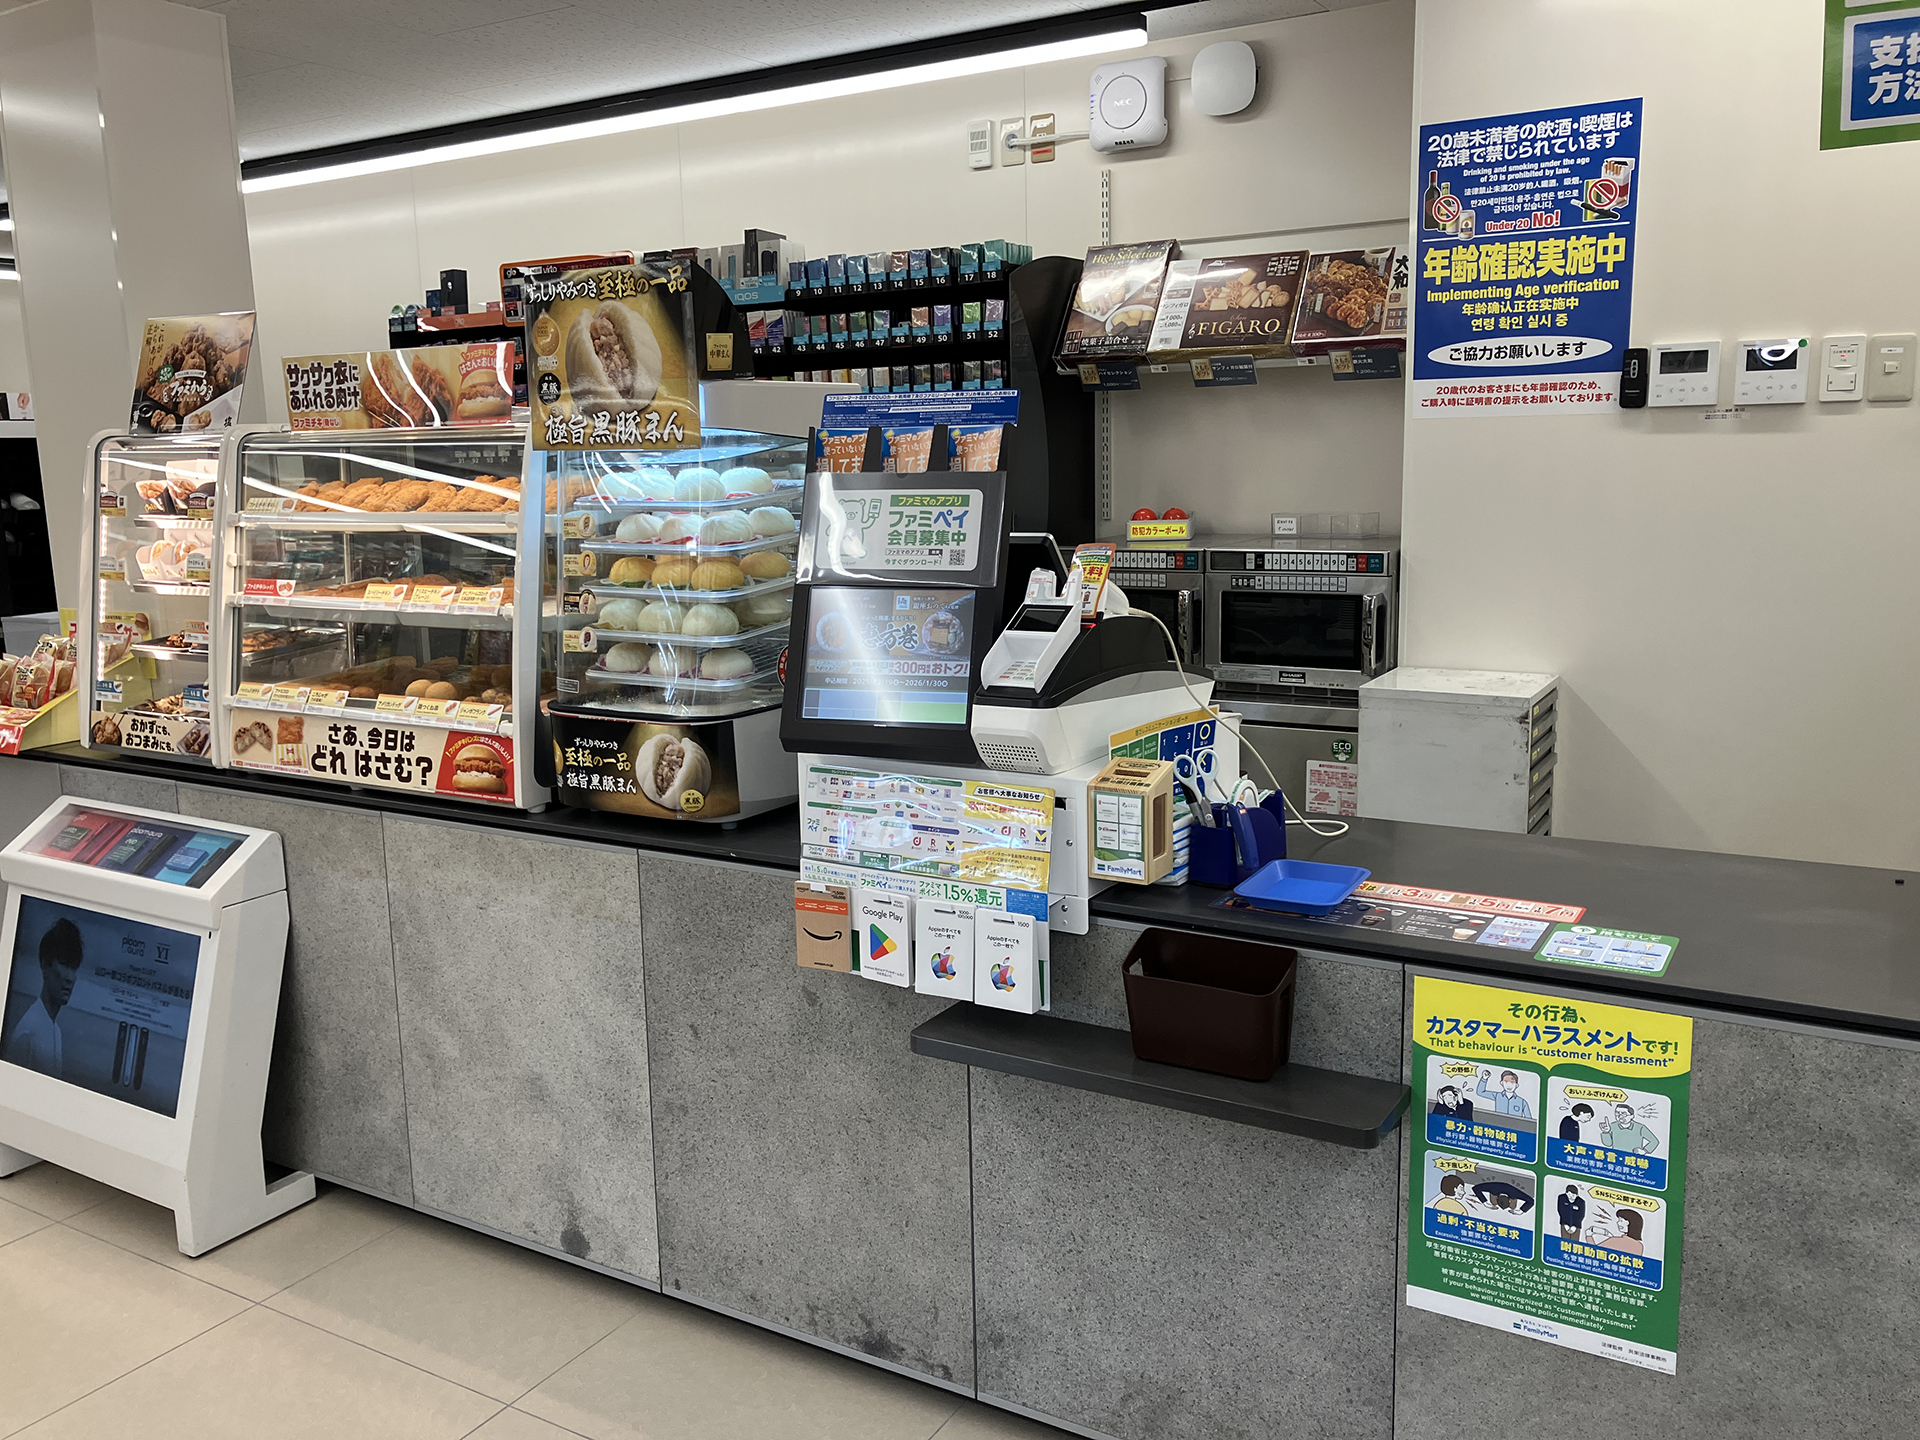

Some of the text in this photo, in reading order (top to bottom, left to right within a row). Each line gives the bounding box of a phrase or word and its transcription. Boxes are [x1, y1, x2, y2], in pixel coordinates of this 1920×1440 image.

[1113, 97, 1133, 107] NEC
[1428, 111, 1634, 152] 20歳未満者の飲酒・喫煙は
[1437, 131, 1621, 168] 法律で禁じられています
[1463, 156, 1591, 177] Drinking and smoking under the age
[1480, 166, 1571, 183] of 20 is prohibited by law.
[1486, 211, 1561, 232] Under 20 No!
[1091, 249, 1163, 264] High Selection
[1423, 232, 1627, 285] 年齢確認実施中
[527, 265, 688, 303] ずっしりやみつき至極の一品
[795, 271, 997, 297] 9 10 11 12 13 14 15 16 17 18
[1427, 279, 1620, 304] Implementing Age verification
[734, 290, 759, 302] IQOS
[1461, 296, 1579, 316] 年龄确认正在实施中
[1196, 318, 1281, 336] FIGARO
[1471, 313, 1569, 331] 연령 확인 실시 중
[753, 329, 998, 355] 41 42 43 44 45 46 47 48 49 50 51 52
[1080, 335, 1130, 346] 焼菓子詰合せ
[1448, 341, 1588, 361] ご協力お願いします
[286, 359, 360, 388] サクサク衣に
[1436, 381, 1602, 395] 20歳代のお客さまにも年齢確認のため、
[290, 386, 361, 411] あふれる肉汁
[1420, 392, 1618, 407] ご購入時に証明書の提示をお願いしております。
[544, 410, 685, 446] 極旨黒豚まん
[898, 495, 962, 506] ファミマのアプリ
[888, 509, 969, 529] ファミペイ
[887, 530, 967, 546] 会員募集中
[1131, 525, 1186, 536] 防犯カラーボール
[459, 707, 487, 715] ジャンボフランク
[130, 718, 171, 737] おかずにも、
[327, 723, 415, 752] さあ、今日は
[1174, 735, 1179, 743] 2
[1186, 732, 1191, 740] 3
[125, 732, 175, 752] おつまみにも。
[574, 737, 619, 750] ずっしりやみつき
[1332, 742, 1352, 750] ECO
[310, 744, 433, 786] どれ はさむ?
[564, 747, 633, 772] 至極の一品
[566, 771, 637, 795] 極旨黒豚まん
[977, 787, 1041, 800] お客様へ大事なお知らせ
[1107, 864, 1142, 876] FamilyMart
[918, 888, 942, 898] ポイント
[919, 880, 942, 890] ファミマ
[943, 882, 1003, 907] 1.5%還元
[862, 905, 904, 924] Google Play
[927, 925, 962, 936] Appleのすべてを
[934, 932, 956, 940] この一枚で
[986, 935, 1021, 945] Appleのすべてを
[122, 934, 146, 949] ploom
[992, 942, 1015, 950] この一枚で
[127, 947, 144, 957] aura
[1507, 1003, 1588, 1024] その行為、
[1426, 1015, 1679, 1056] カスタマーハラスメントです!
[1429, 1037, 1675, 1068] That behaviour is “customer harassment”
[1568, 1087, 1624, 1100] おい!ふざけんな!
[1445, 1119, 1518, 1143] 暴力・器物破損
[1435, 1136, 1527, 1159] Physical violence, property damage
[1563, 1143, 1650, 1170] 大声・暴言・威嚇
[1555, 1160, 1656, 1186] Threatening, intimidating behaviour
[1595, 1188, 1653, 1208] SNSに公開するぞ!
[1436, 1213, 1520, 1241] 過剰・不当な要求
[1461, 1230, 1494, 1243] 強要罪など
[1434, 1230, 1522, 1255] Excessive, unreasonable demands
[1560, 1241, 1644, 1270] 謝罪動画の拡散
[1546, 1255, 1659, 1288] Posting videos that privacy
[1448, 1279, 1464, 1289] your
[1464, 1282, 1499, 1297] behaviour
[1506, 1293, 1542, 1308] recognized
[1542, 1302, 1552, 1310] as
[1481, 1293, 1494, 1302] will
[1494, 1297, 1515, 1309] report
[1524, 1304, 1537, 1312] the
[1537, 1307, 1558, 1319] police
[1559, 1311, 1605, 1331] immediately.
[1523, 1325, 1559, 1340] FamilyMart
